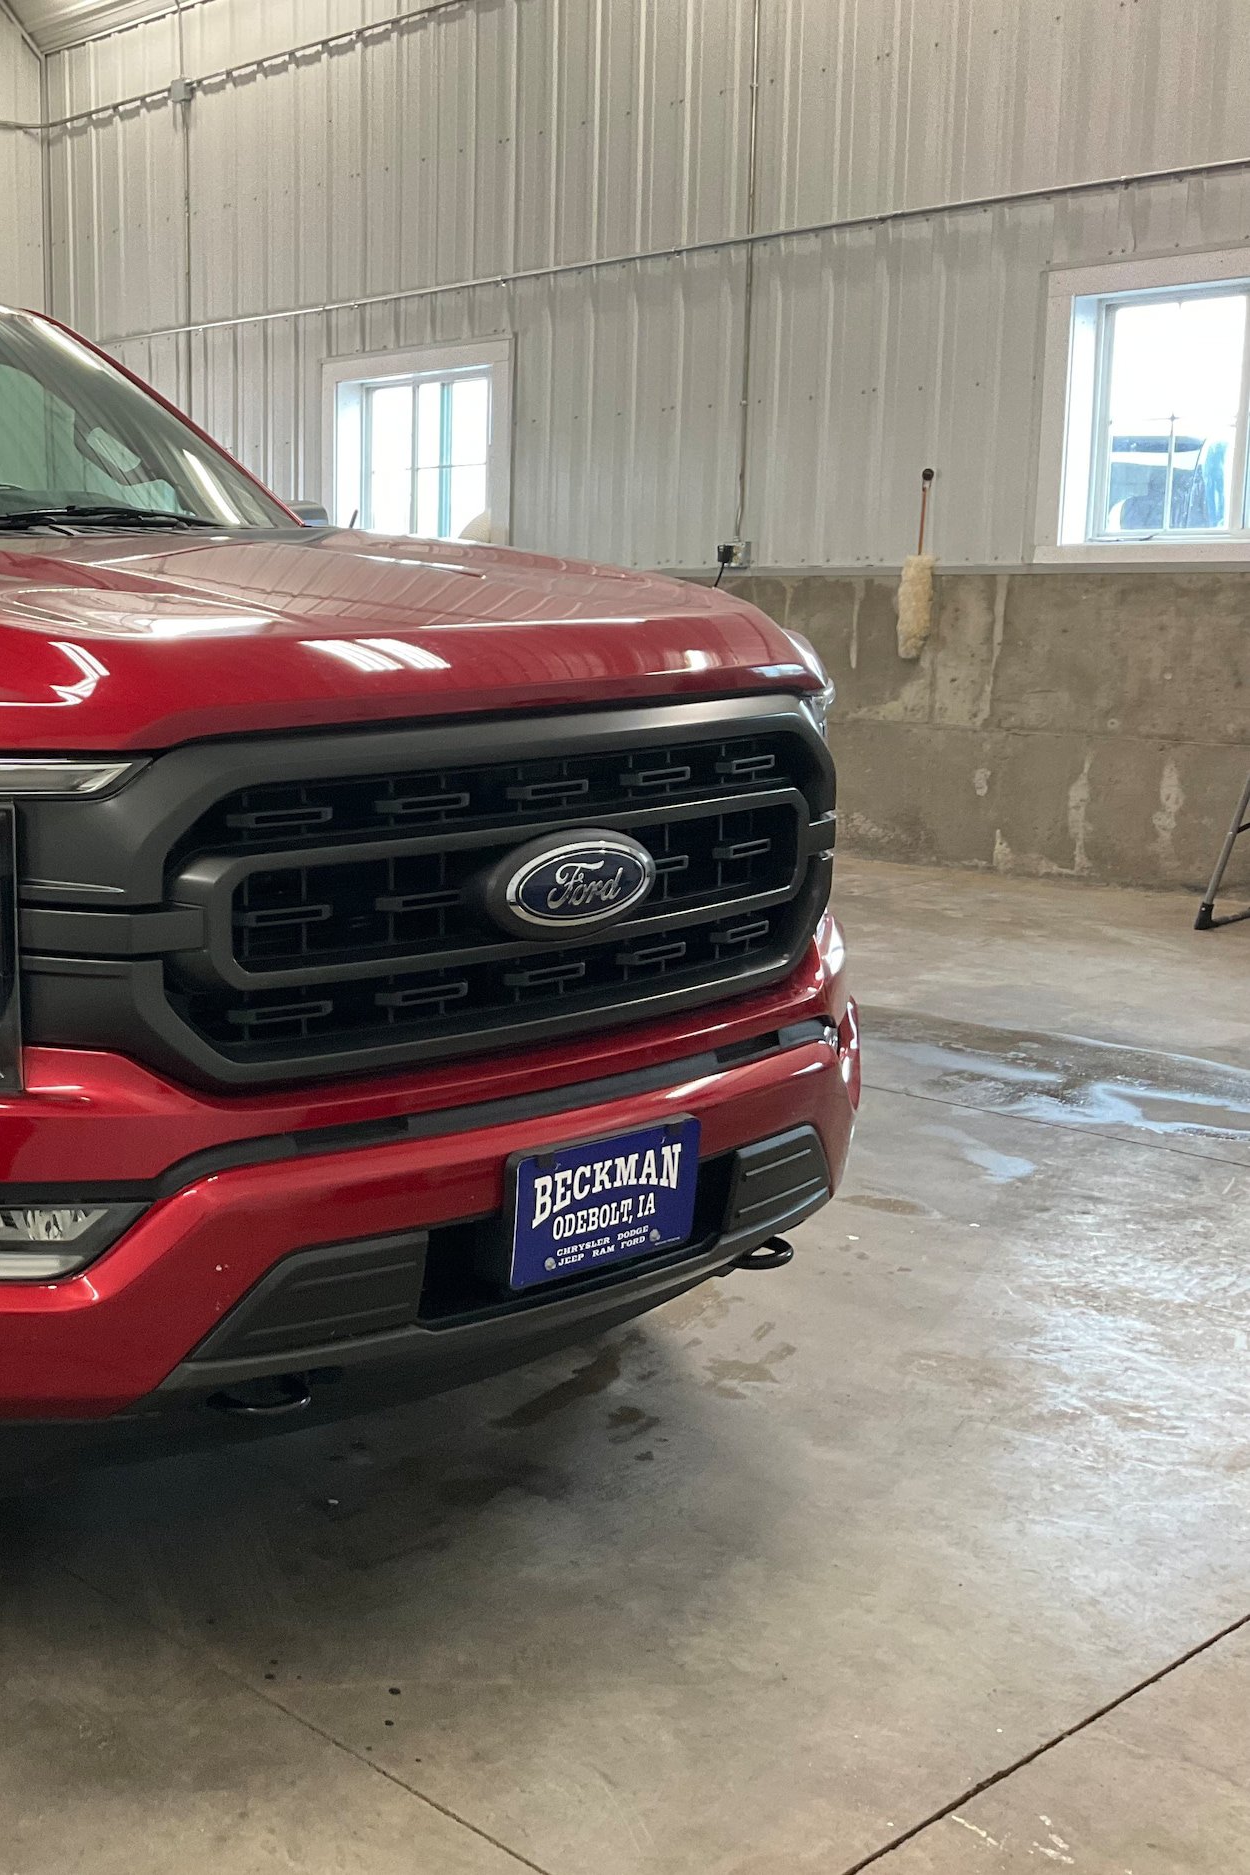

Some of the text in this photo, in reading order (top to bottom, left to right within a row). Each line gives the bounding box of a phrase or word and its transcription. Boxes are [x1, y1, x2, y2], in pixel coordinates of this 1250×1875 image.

[547, 860, 623, 909] Ford
[532, 1143, 682, 1229] BECKMAN
[553, 1192, 656, 1240] ODEBOLT, IA
[556, 1225, 649, 1257] CHRYSLER DODGE
[558, 1253, 585, 1266] JEEP
[592, 1244, 615, 1258] RAM
[620, 1235, 646, 1249] FORD
